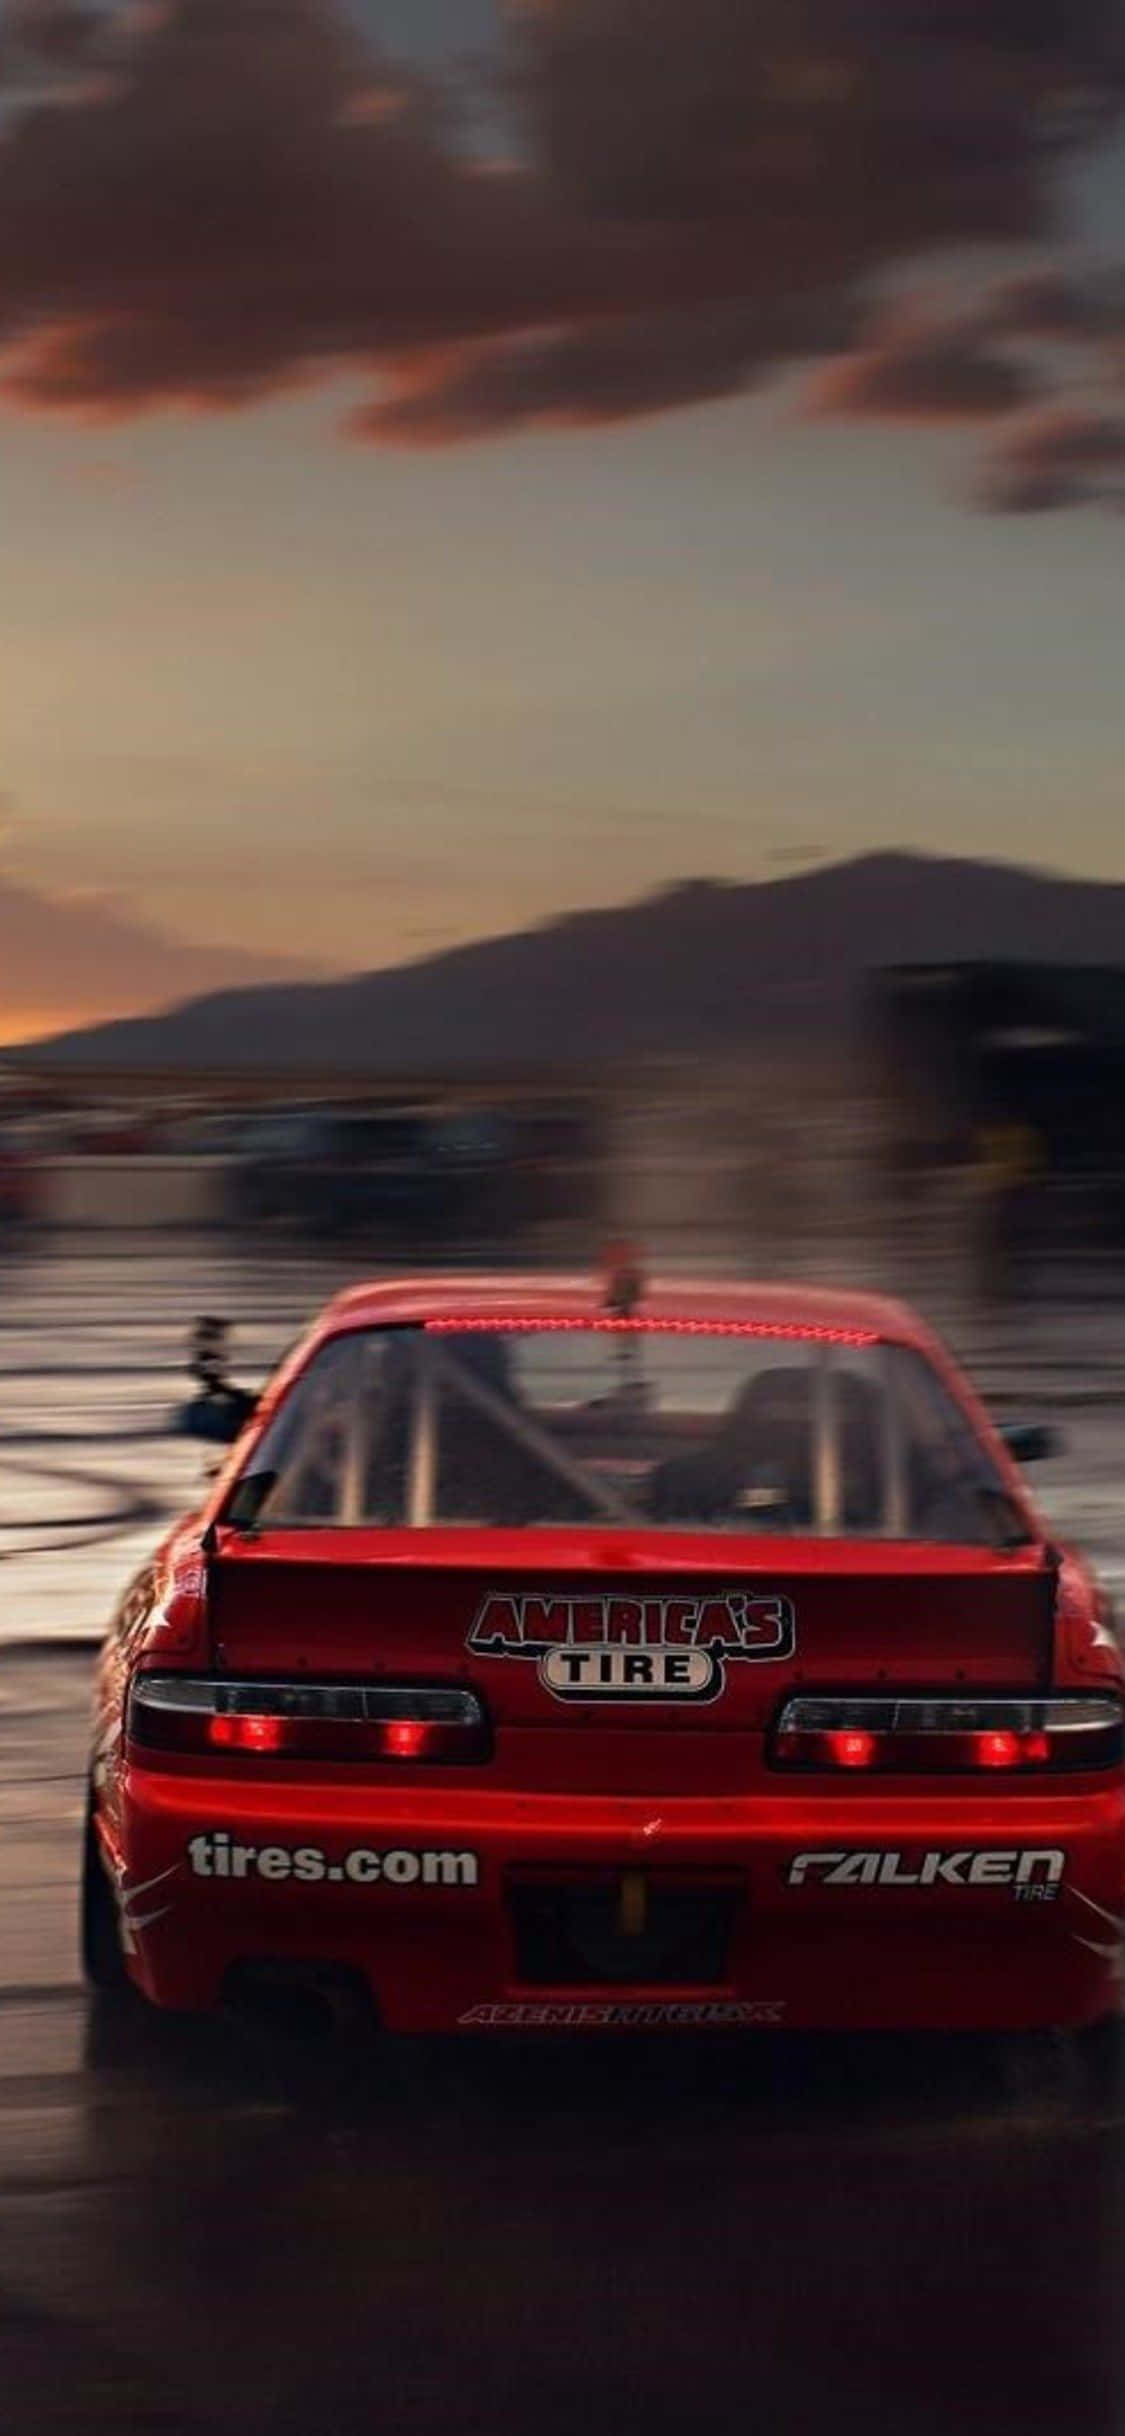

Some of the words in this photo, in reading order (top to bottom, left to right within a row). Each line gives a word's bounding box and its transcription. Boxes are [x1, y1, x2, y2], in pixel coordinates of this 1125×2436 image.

[467, 1594, 794, 1656] AMERICA'S
[560, 1654, 691, 1684] TIRE
[188, 1833, 478, 1885] tires.com
[788, 1850, 1065, 1884] FALKEN
[1013, 1882, 1057, 1901] TIRE
